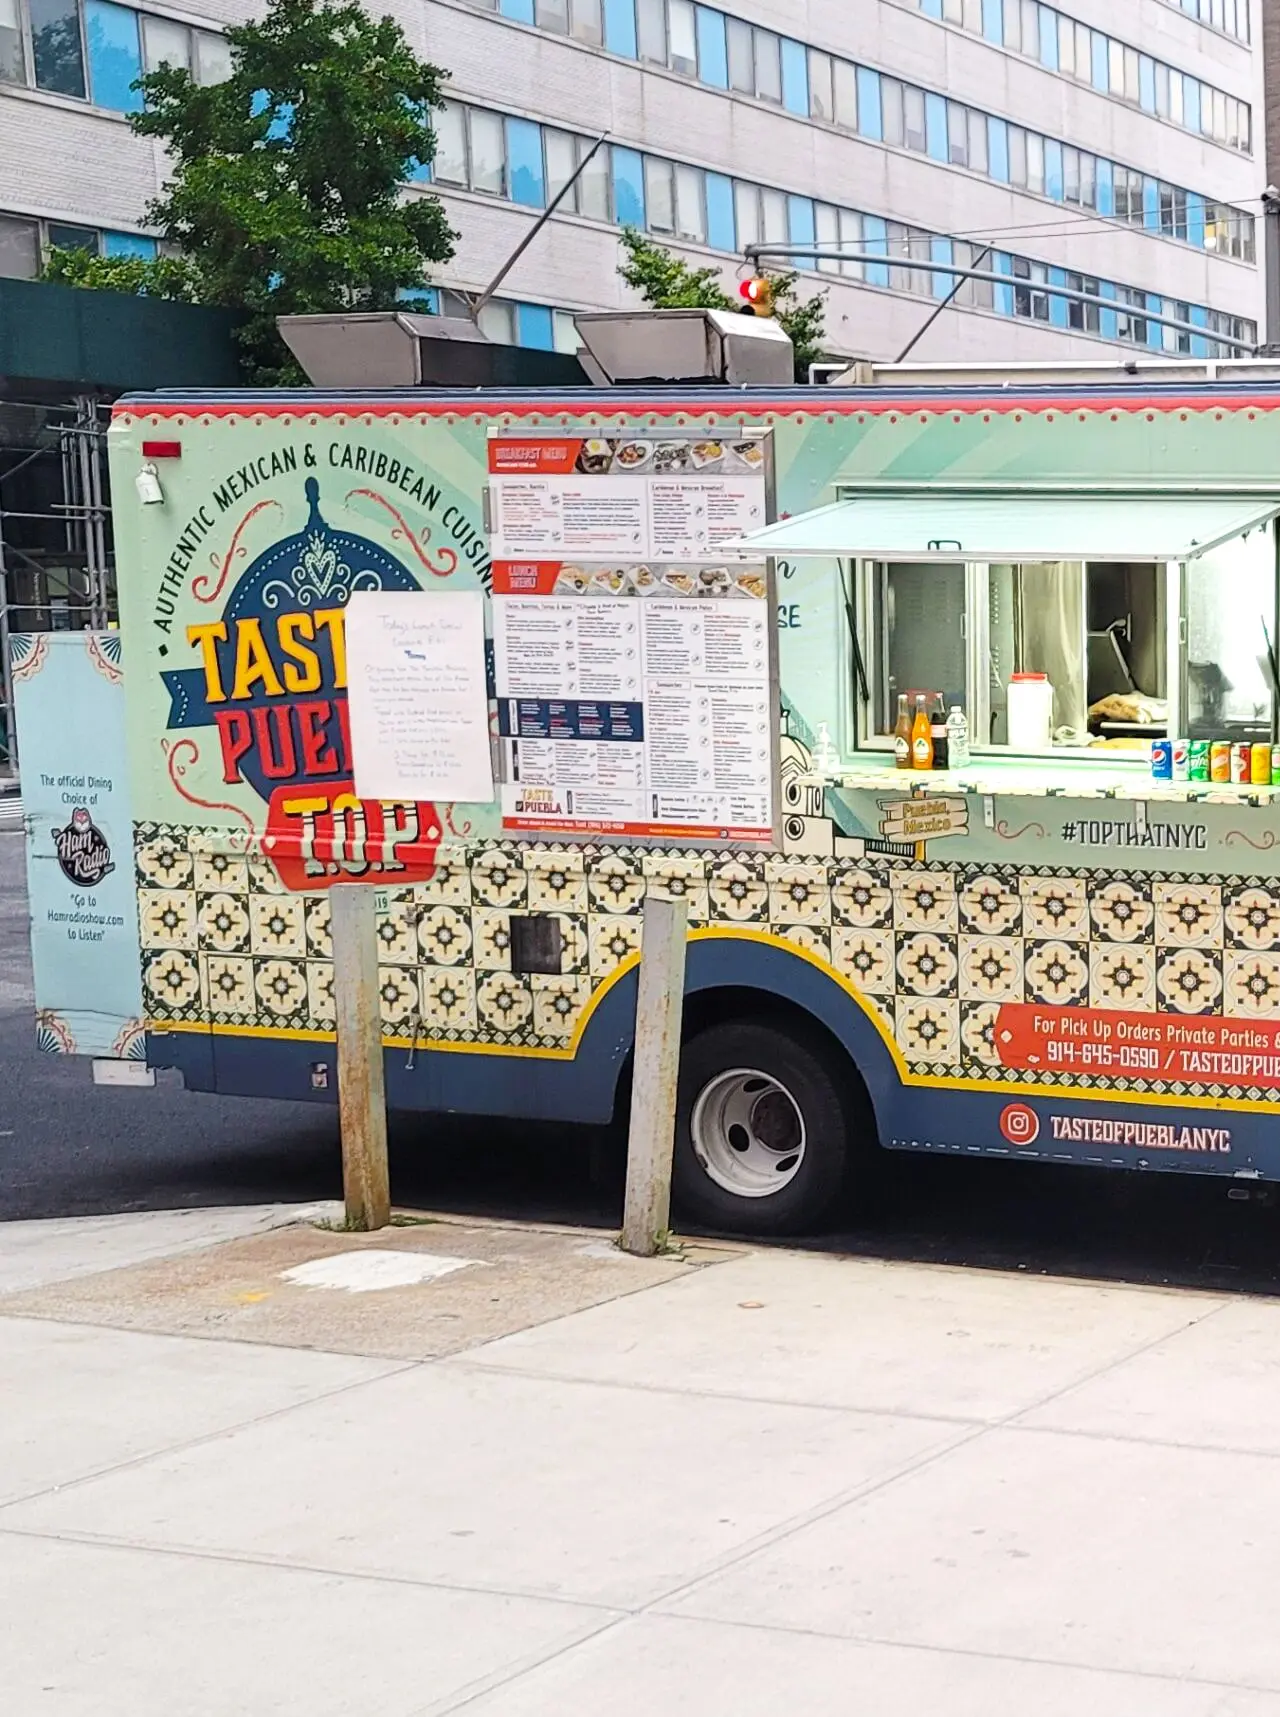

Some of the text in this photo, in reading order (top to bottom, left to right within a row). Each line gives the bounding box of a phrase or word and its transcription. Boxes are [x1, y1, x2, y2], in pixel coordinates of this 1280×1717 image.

[153, 505, 216, 634] AUTHENTIC
[212, 445, 297, 513] MEXICAN
[303, 443, 317, 468] &
[329, 442, 441, 511] CARIBBEAN
[186, 607, 348, 703] TAST
[213, 697, 353, 784] PUE
[40, 774, 112, 792] The official Dining
[61, 792, 98, 805] Choice of
[525, 802, 562, 814] PUEBLA
[56, 830, 94, 858] Ham
[1061, 820, 1207, 849] #TOPTHATNYC
[72, 845, 110, 880] Radio
[87, 896, 97, 907] to
[47, 911, 124, 926] Hamradioshow.com
[67, 928, 77, 940] to
[1034, 1015, 1056, 1034] For
[1061, 1017, 1088, 1036] Pick
[1094, 1020, 1112, 1039] Up
[1117, 1021, 1161, 1042] Orders
[1167, 1024, 1215, 1045] Private
[1221, 1027, 1268, 1049] Parties
[1047, 1040, 1159, 1070] 914-645-0590
[1051, 1116, 1231, 1153] TASTEOFPUEBLANYC
